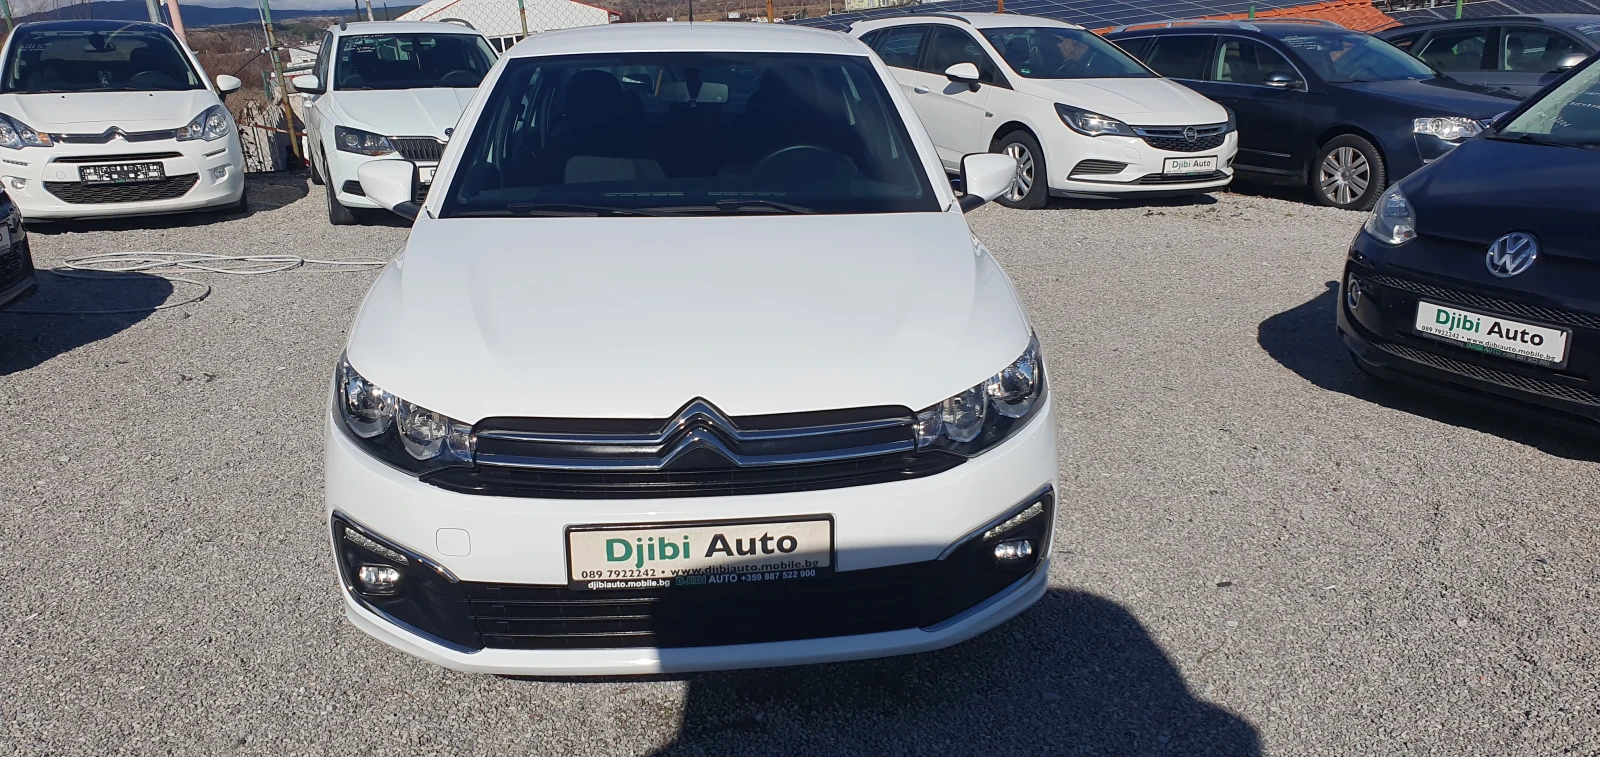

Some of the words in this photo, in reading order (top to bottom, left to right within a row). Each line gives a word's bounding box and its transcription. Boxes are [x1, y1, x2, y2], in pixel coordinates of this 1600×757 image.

[1434, 328, 1460, 339] 7922242
[1436, 308, 1480, 332] Djibi
[1486, 322, 1544, 346] Auto
[606, 535, 690, 568] Djibi
[704, 532, 798, 558] Auto
[582, 570, 602, 578] 089
[607, 568, 656, 578] 7922242
[670, 560, 818, 576] www.djibiauto.mobile.bg
[588, 579, 670, 590] djibiauto.mobile.bg
[708, 574, 738, 584] AUTO
[741, 573, 762, 581] +359
[764, 572, 780, 580] 887
[800, 569, 816, 577] 900
